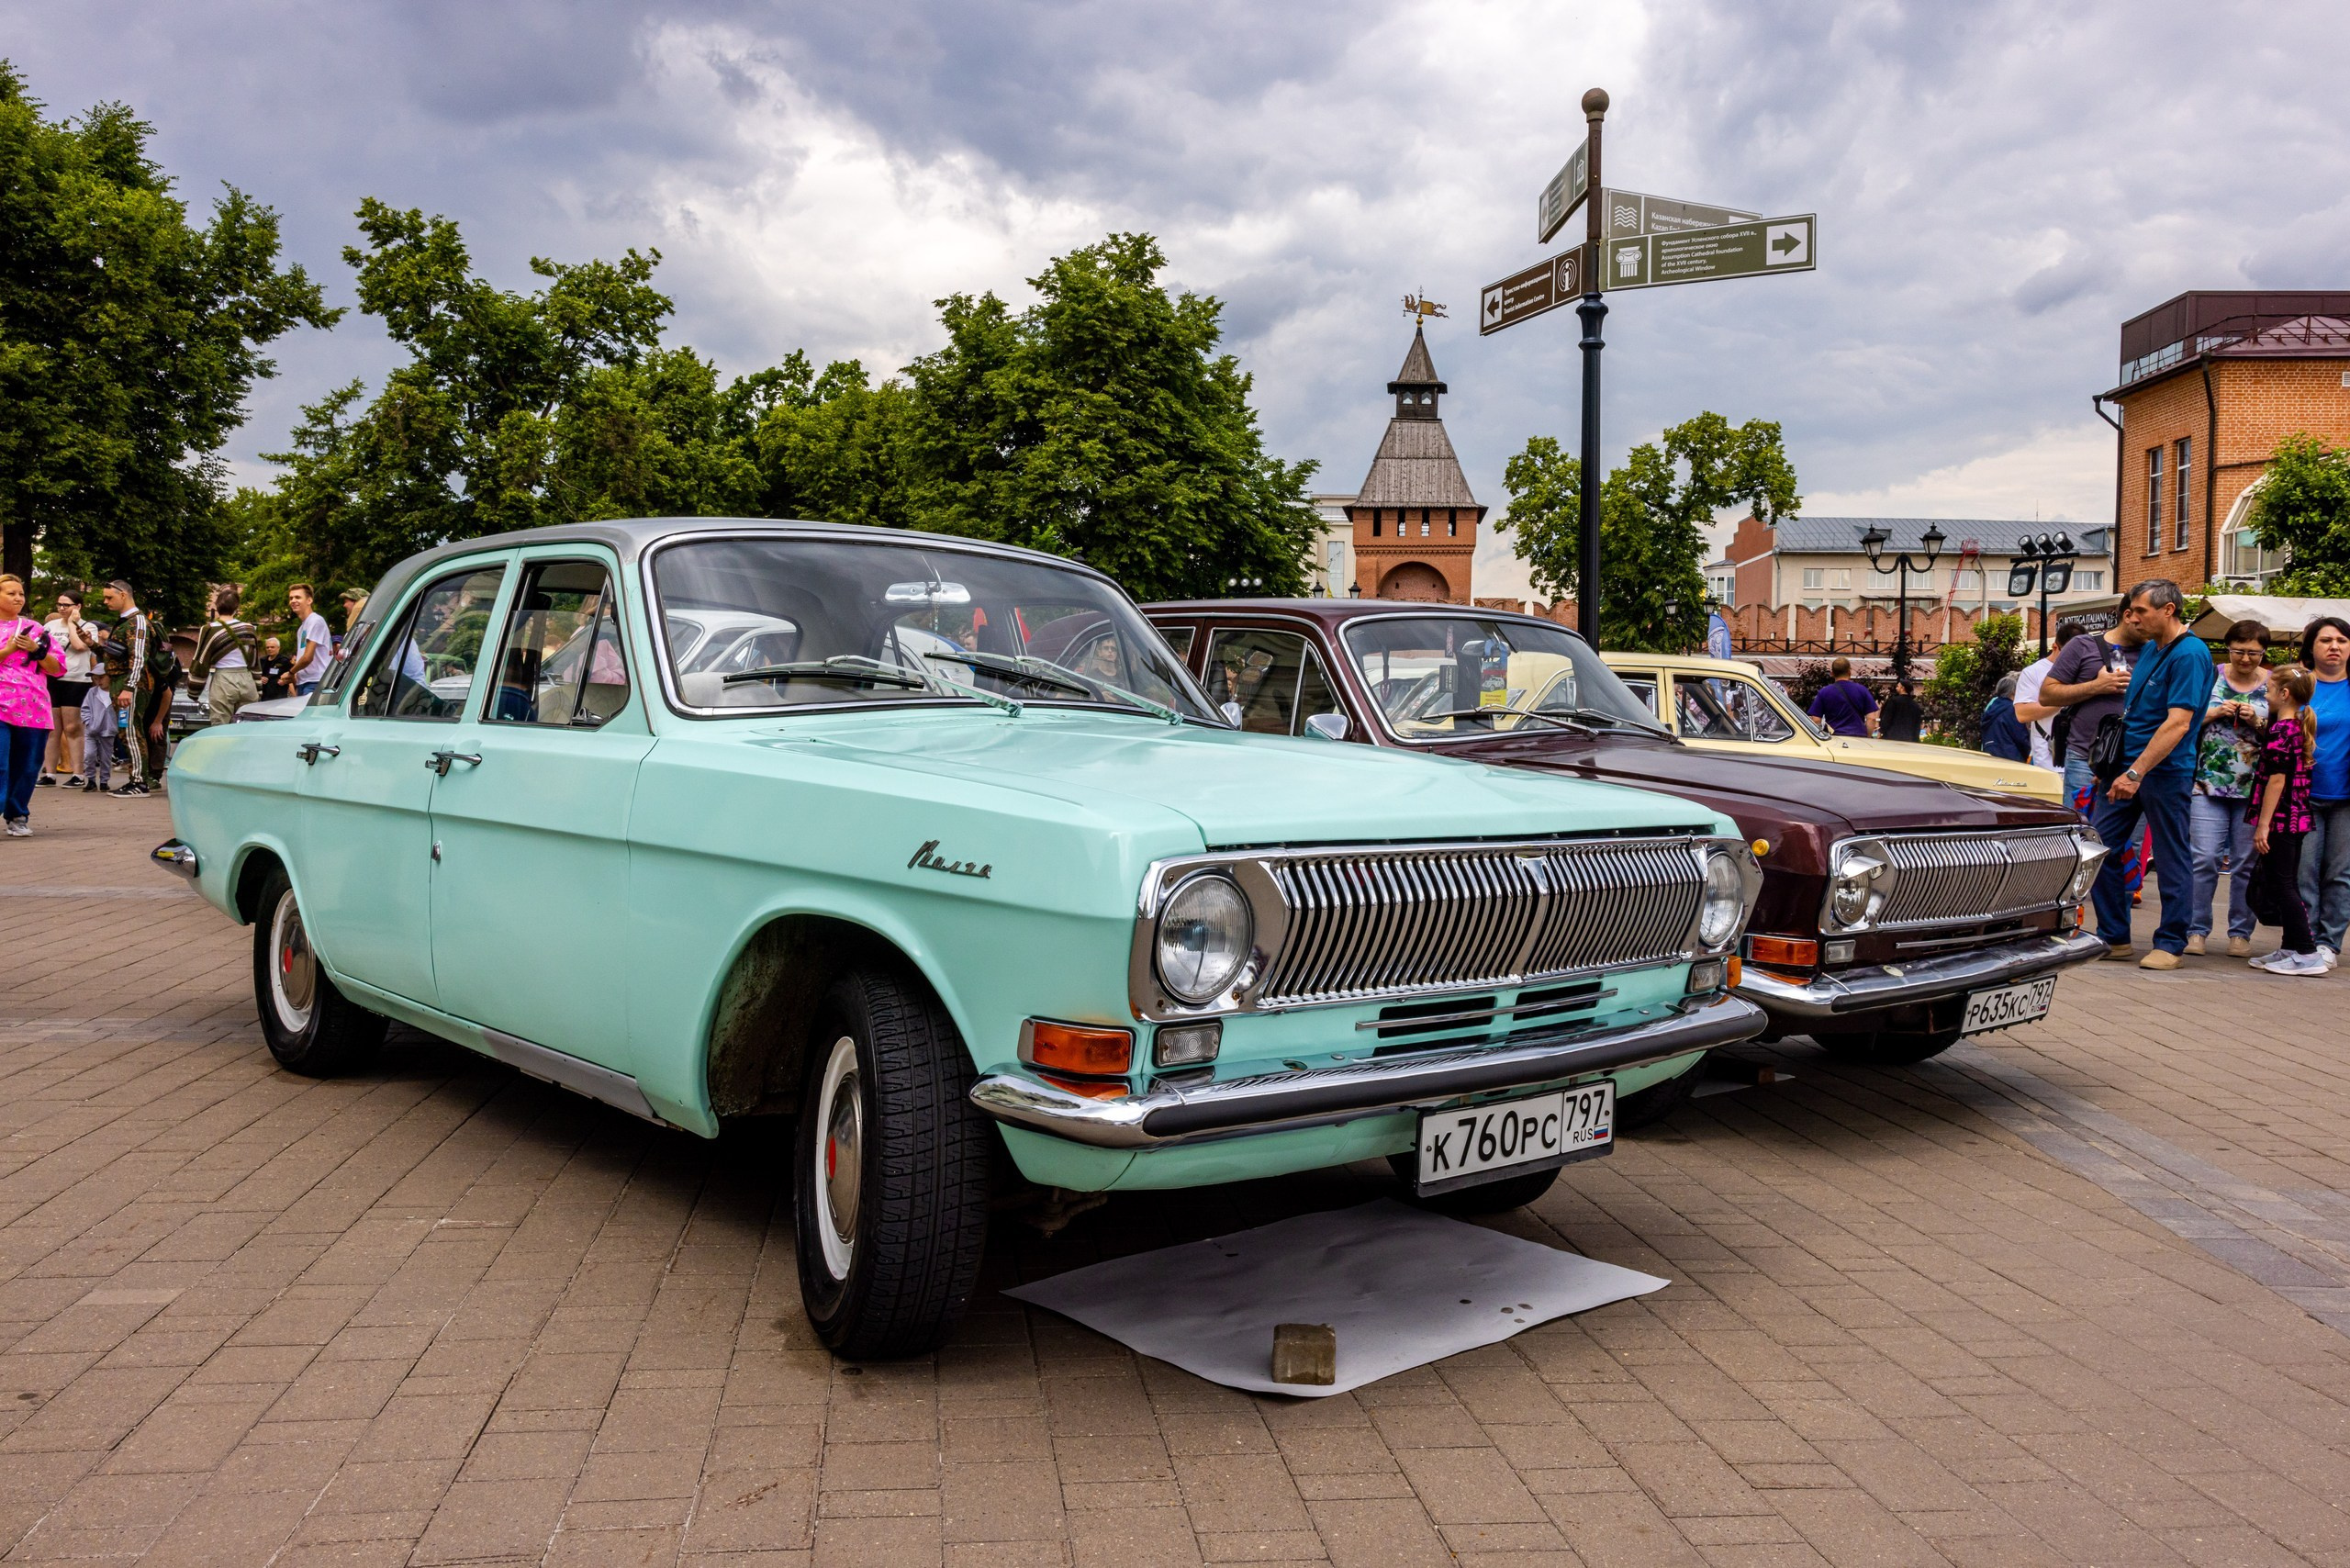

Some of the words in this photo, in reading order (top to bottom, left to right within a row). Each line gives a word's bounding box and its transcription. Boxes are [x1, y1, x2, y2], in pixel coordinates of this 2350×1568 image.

[1651, 211, 1682, 224] Казанская
[1682, 218, 1718, 228] набережн
[1651, 222, 1669, 231] Kazan
[1662, 239, 1691, 247] Фундамент
[1691, 235, 1720, 243] Успенского
[1662, 244, 1705, 253] археологическое
[1691, 249, 1716, 257] Cathedral
[1662, 266, 1695, 274] Archeological
[1505, 306, 1515, 314] Tourist
[1515, 298, 1534, 310] Information
[1534, 294, 1545, 302] Centre
[2065, 614, 2086, 624] BOTTEGA
[2086, 612, 2108, 623] ITALIANA
[907, 839, 992, 879] Волга
[1968, 991, 2028, 1027] Р635КС
[2030, 980, 2052, 1006] 797
[1433, 1110, 1559, 1172] К760РС
[1566, 1089, 1606, 1132] 797
[1572, 1127, 1594, 1144] RUS
